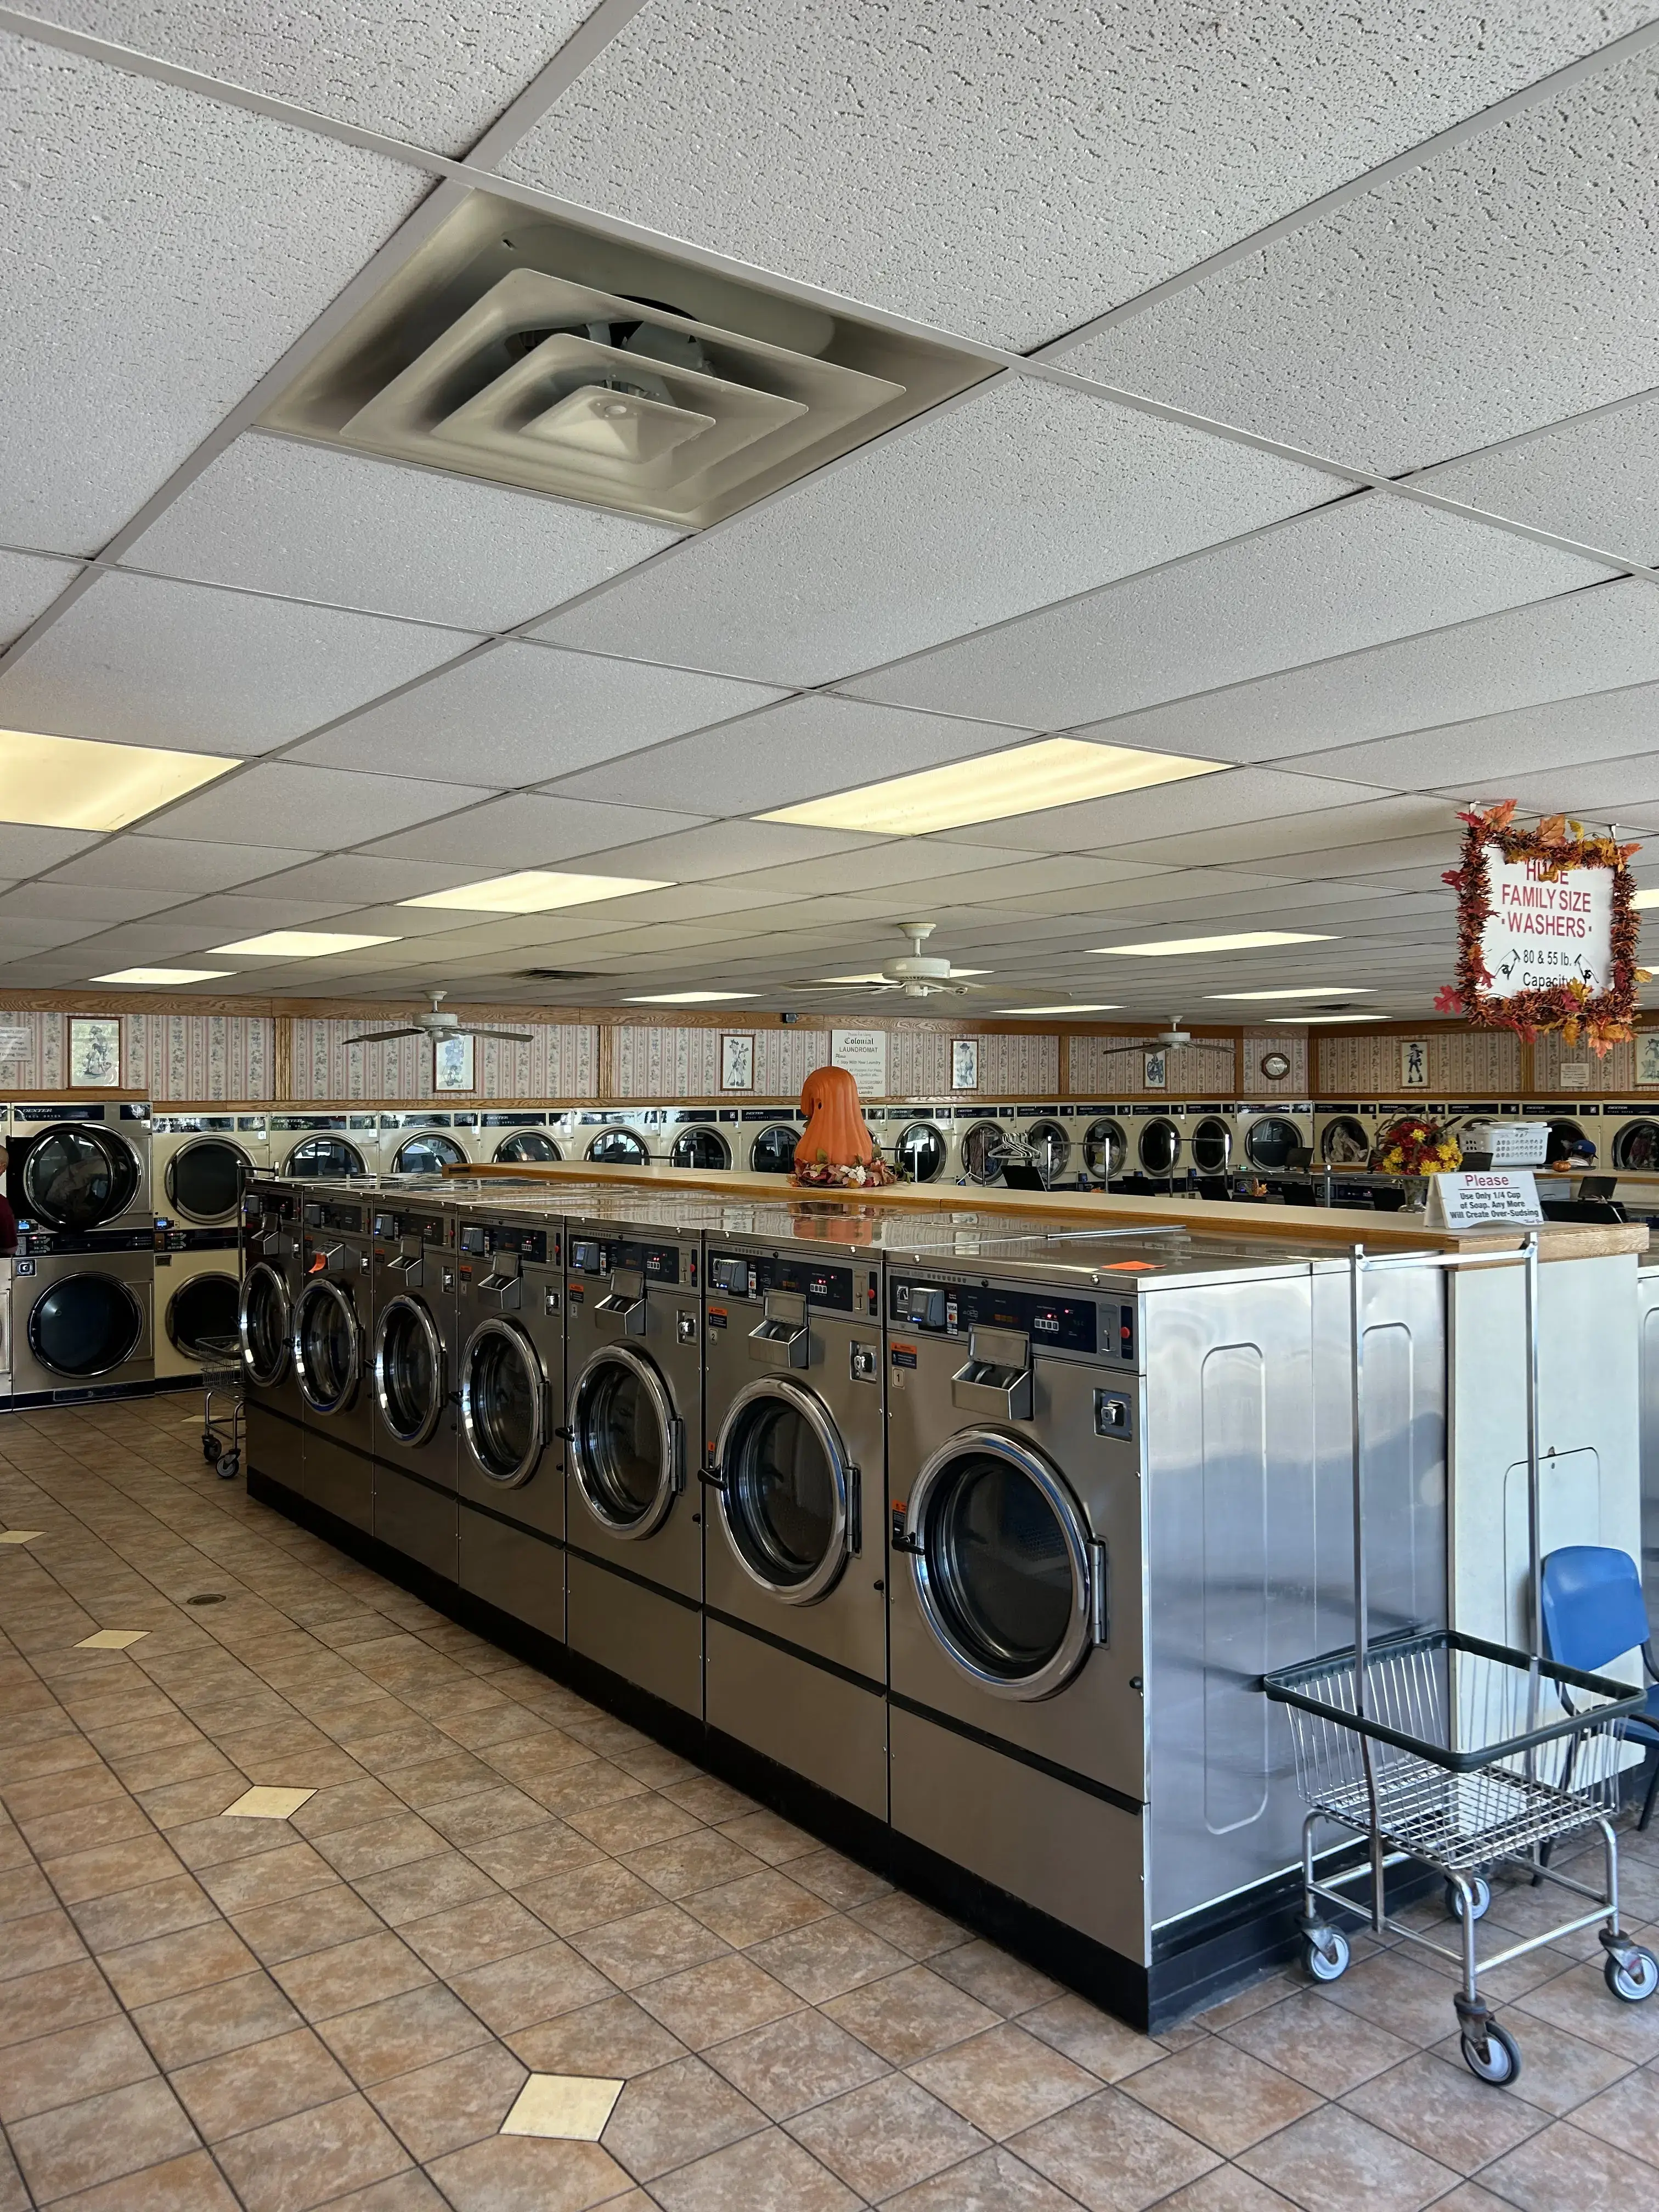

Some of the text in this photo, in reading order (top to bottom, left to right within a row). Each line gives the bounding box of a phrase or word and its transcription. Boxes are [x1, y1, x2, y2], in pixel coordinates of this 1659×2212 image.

[1526, 860, 1569, 885] HUE
[1502, 884, 1592, 912] FAMILY SIZE
[1508, 911, 1585, 938] WASHERS
[1523, 949, 1572, 966] 80 & 55 lb.
[1465, 1175, 1509, 1186] Please
[1475, 1192, 1491, 1200] Only
[1507, 1191, 1521, 1199] Cup
[1469, 1201, 1491, 1210] Soap.
[1492, 1201, 1505, 1209] Any
[1491, 1209, 1539, 1217] Over-Sudsing
[711, 1333, 715, 1341] 2
[896, 1373, 900, 1383] 1
